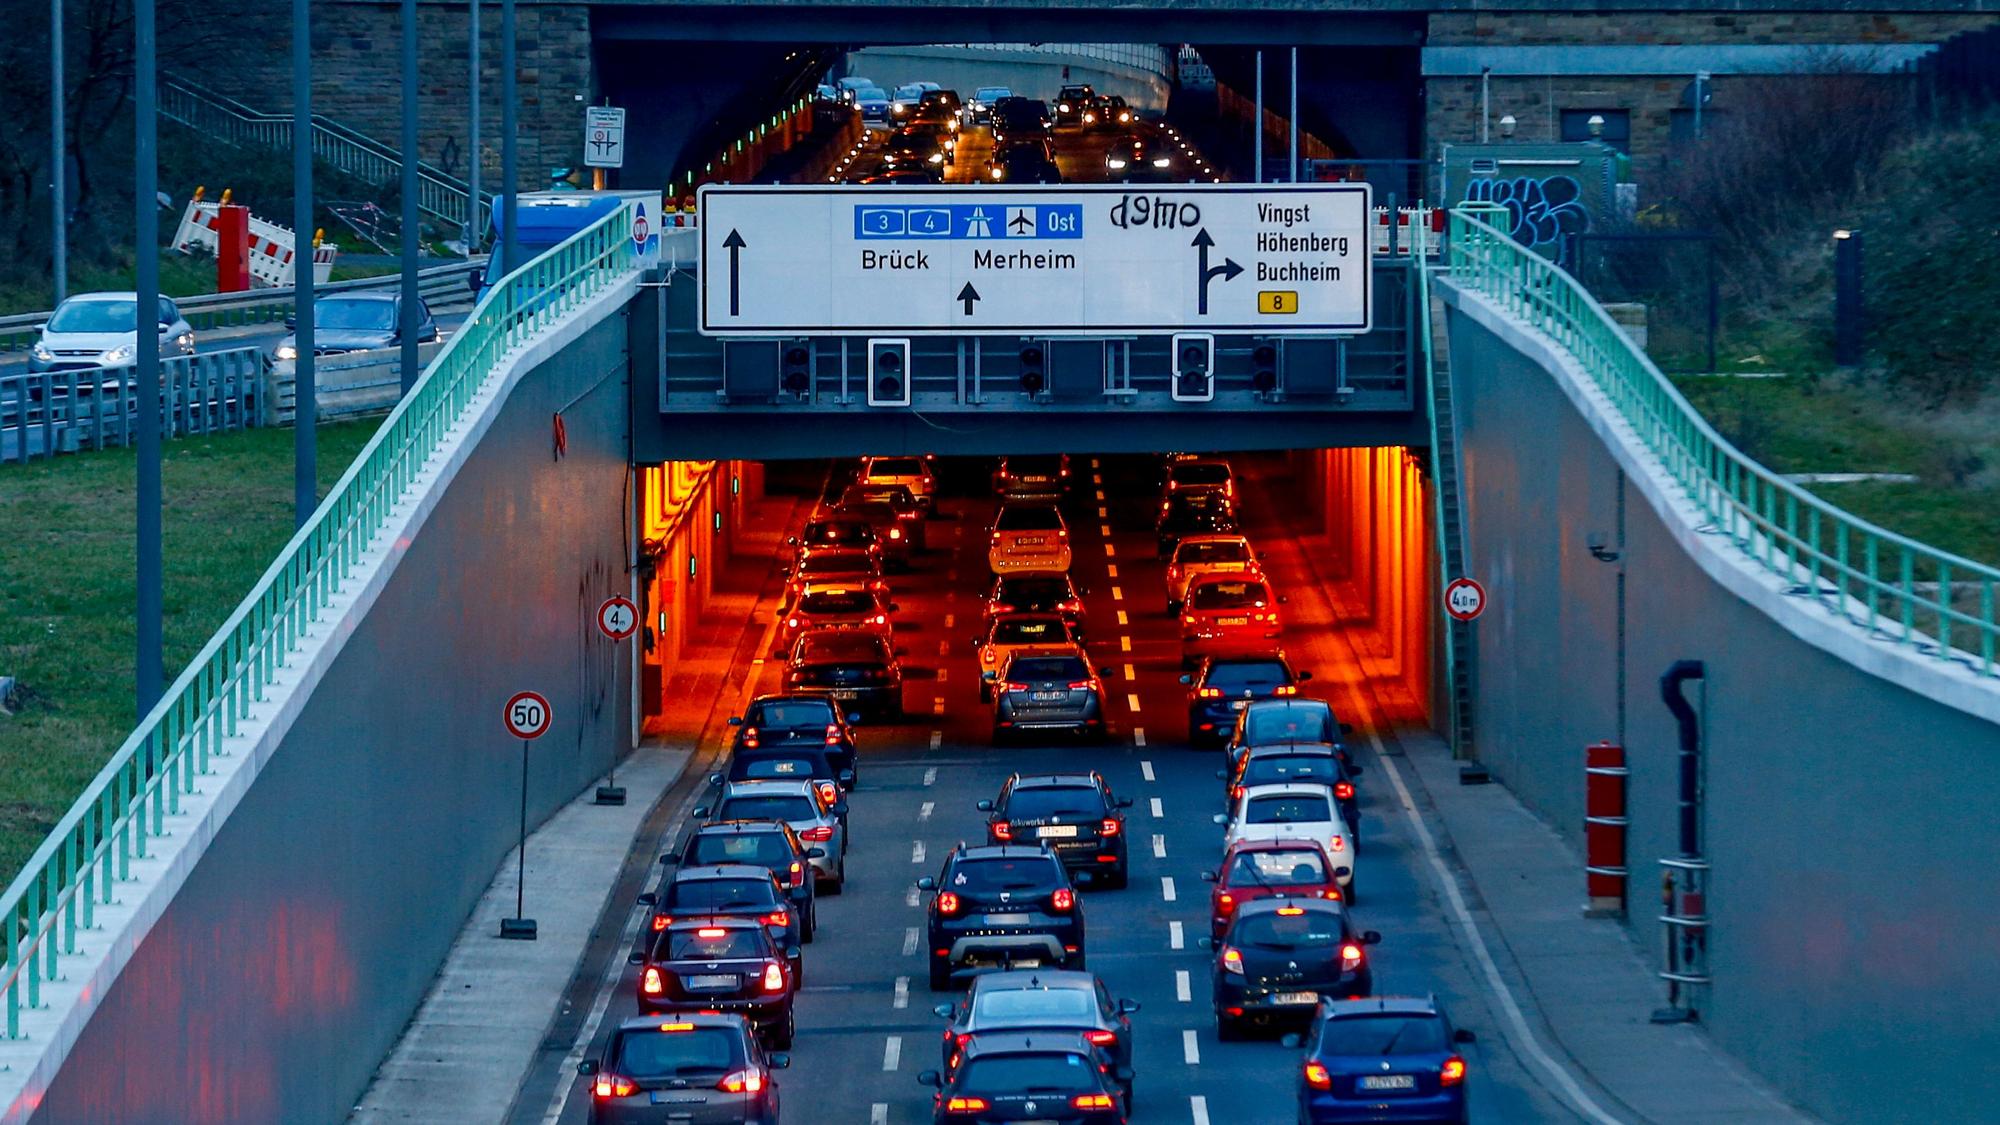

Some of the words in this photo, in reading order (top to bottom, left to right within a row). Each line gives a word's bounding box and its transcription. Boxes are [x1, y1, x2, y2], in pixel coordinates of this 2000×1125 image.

[879, 215, 888, 230] 3
[924, 215, 935, 230] 4
[1048, 212, 1075, 231] Ost
[1257, 203, 1310, 227] Vingst
[1257, 232, 1348, 257] Höhenberg
[862, 249, 929, 270] Brück
[974, 249, 1075, 270] Merheim
[1257, 261, 1340, 281] Buchheim
[1273, 295, 1283, 310] 8
[514, 705, 541, 727] 50
